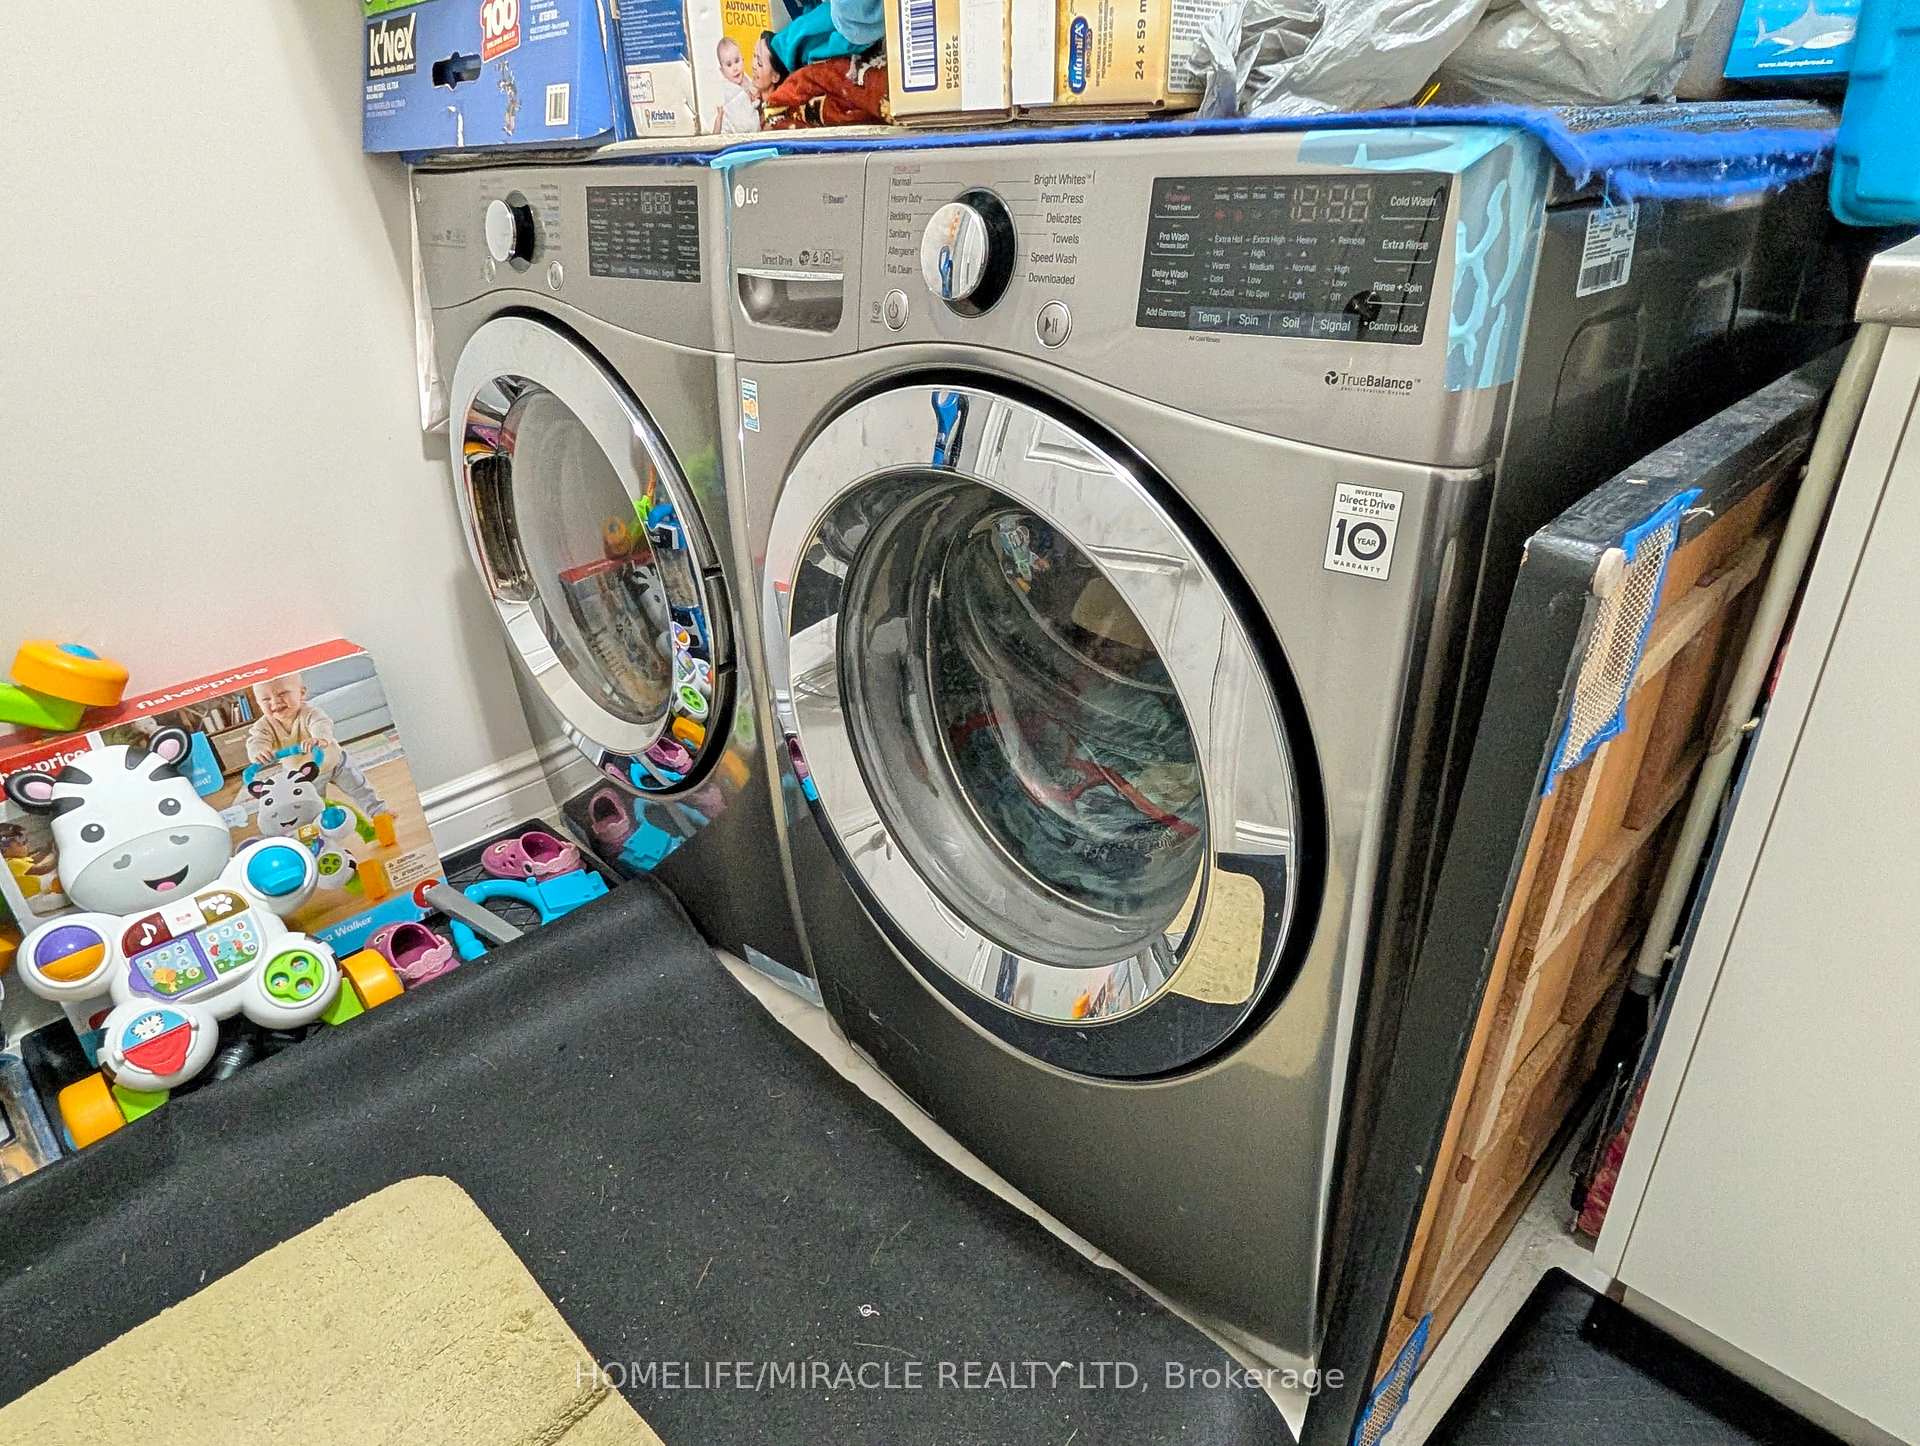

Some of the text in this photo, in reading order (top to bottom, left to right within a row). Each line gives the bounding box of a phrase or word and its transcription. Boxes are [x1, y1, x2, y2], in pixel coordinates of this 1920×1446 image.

[725, 0, 767, 12] AUTOMATIC
[483, 0, 517, 39] 100
[725, 11, 767, 28] CRADLE
[1137, 19, 1146, 40] 59
[1138, 45, 1145, 54] x
[1135, 60, 1144, 80] 24
[651, 109, 675, 122] Krishna
[892, 177, 912, 187] Normal
[1034, 174, 1057, 187] Bright
[745, 187, 759, 204] LG
[891, 193, 922, 204] Heavy Duty
[1390, 195, 1437, 207] Cold Wash
[889, 211, 912, 223] Bedding
[1046, 213, 1082, 224] Delicates
[888, 228, 912, 240] Sanitary
[1052, 233, 1080, 244] Towels
[1170, 232, 1190, 241] Wash
[1214, 234, 1243, 244] Extra Hot
[1252, 235, 1286, 246] Extra High
[1296, 235, 1318, 246] Heavy
[1382, 239, 1429, 250] Extra Rinse
[1030, 252, 1077, 264] Speed Wash
[1213, 249, 1224, 257] Hot
[1251, 249, 1266, 259] High
[888, 264, 913, 275] Tub Clean
[1212, 263, 1231, 271] Warm
[1292, 264, 1317, 273] Normal
[1334, 264, 1350, 275] High
[1028, 272, 1076, 285] Downloaded
[1152, 268, 1189, 279] Delay Wash
[1247, 276, 1262, 285] Low
[1332, 279, 1347, 288] Low
[1373, 281, 1396, 292] Rinse
[1404, 282, 1423, 293] Spin
[1245, 289, 1255, 298] No
[1288, 290, 1306, 301] Light
[1145, 307, 1186, 318] Add Garments
[1198, 311, 1223, 324] Temp.
[1239, 313, 1259, 326] Spin
[1282, 316, 1300, 328] Soil
[1320, 318, 1351, 332] Signal
[1368, 321, 1419, 333] Control Lock
[1355, 488, 1383, 499] INVERTER
[1339, 493, 1396, 512] Direct Drive
[1352, 506, 1380, 516] MOTOR
[1334, 518, 1387, 561] 10
[1357, 536, 1377, 547] YEAR
[1333, 559, 1381, 574] WARRANTY
[334, 916, 373, 937] Walker
